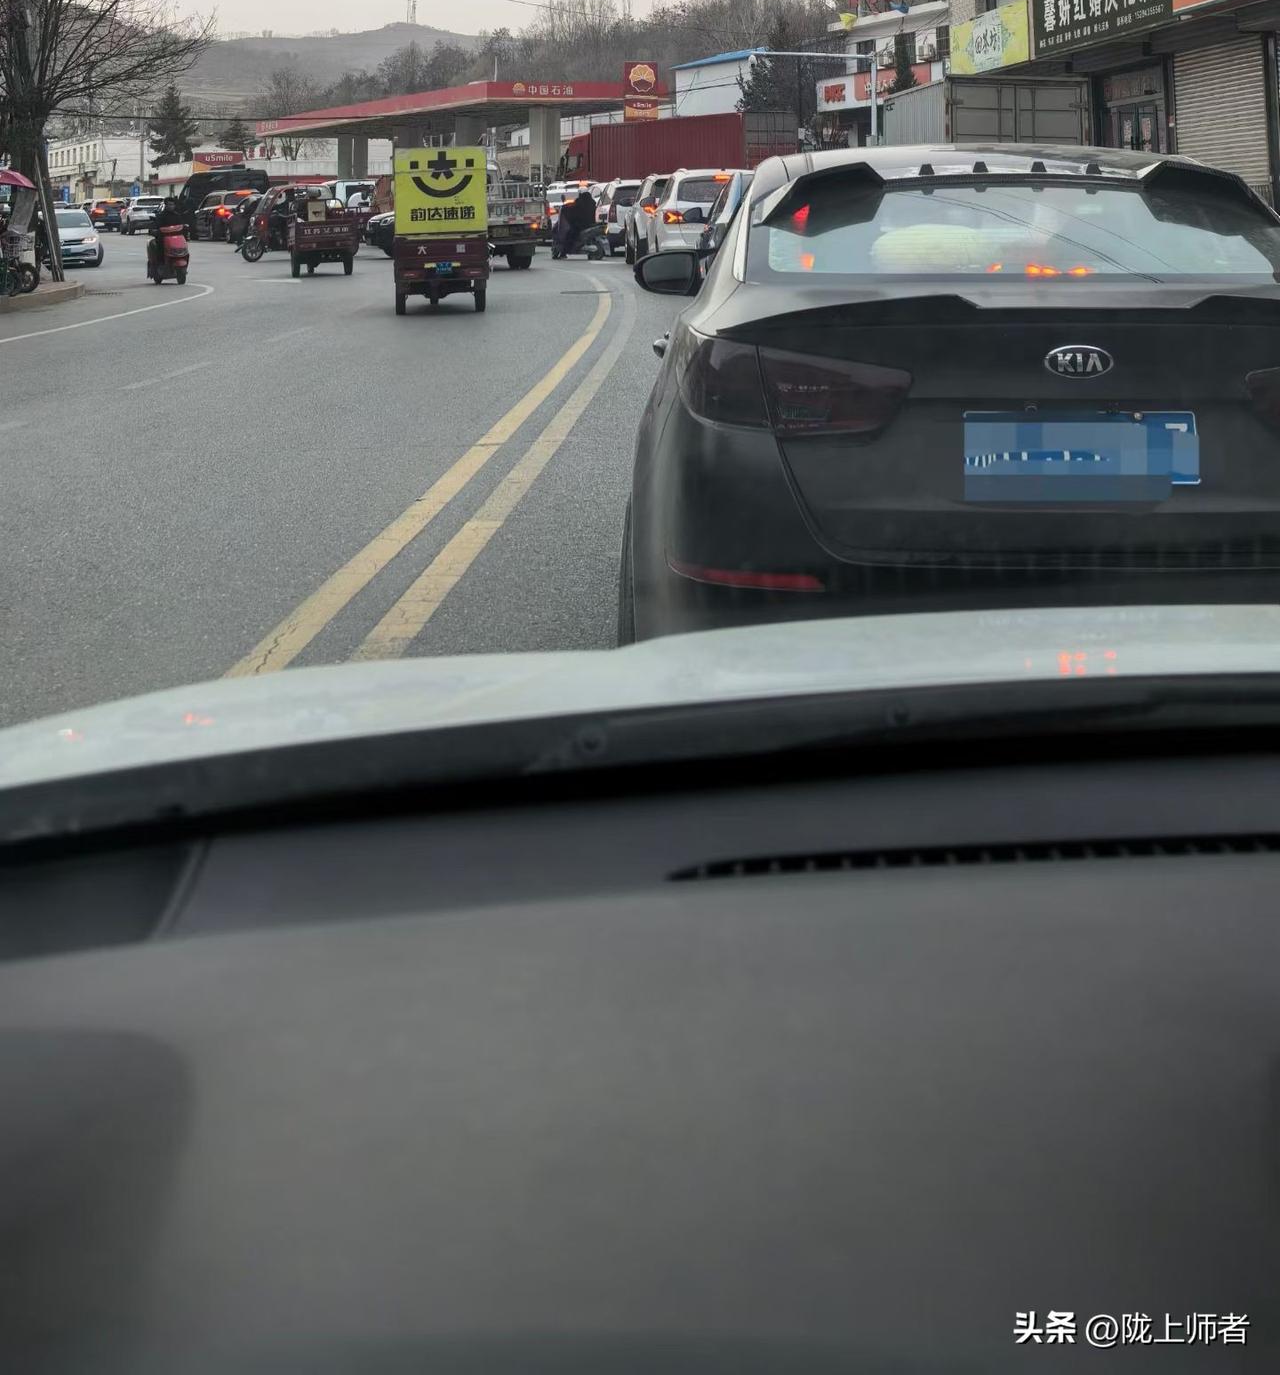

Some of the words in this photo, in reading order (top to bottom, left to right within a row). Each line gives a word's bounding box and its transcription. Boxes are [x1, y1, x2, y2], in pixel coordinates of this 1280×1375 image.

[528, 85, 573, 96] 中国石油
[205, 153, 233, 162] uSmile
[410, 206, 476, 221] 韵达速递
[1057, 353, 1104, 372] KIA
